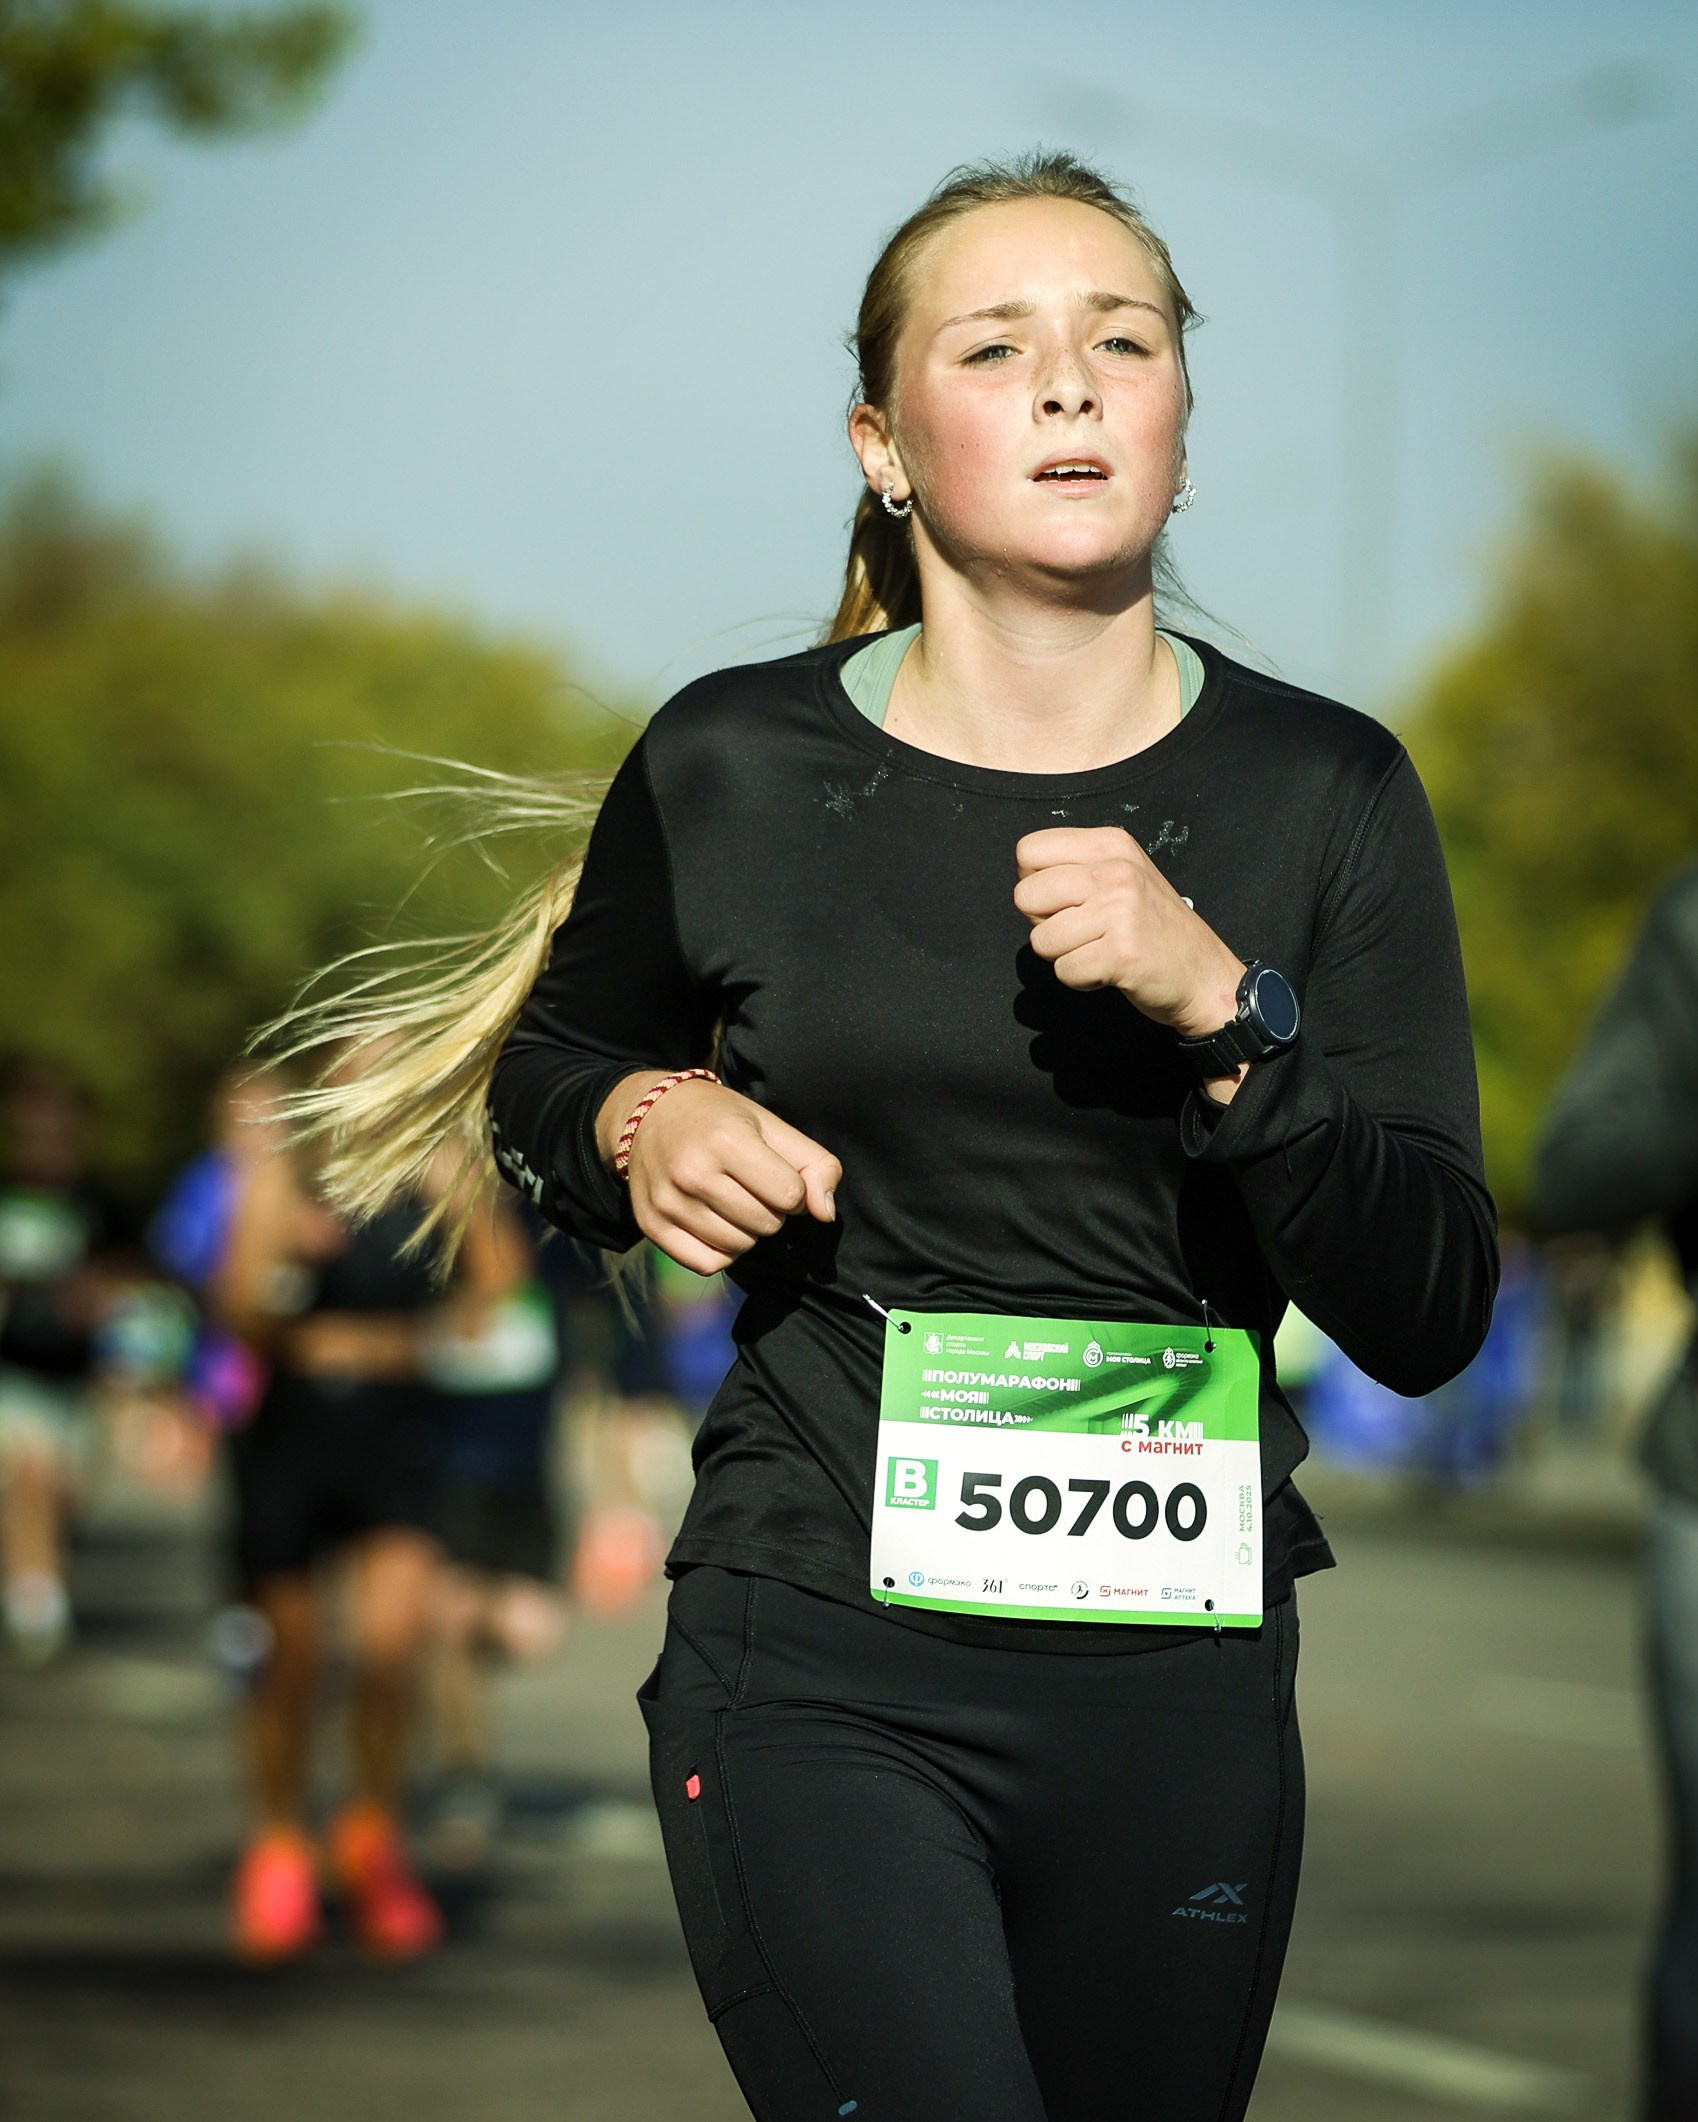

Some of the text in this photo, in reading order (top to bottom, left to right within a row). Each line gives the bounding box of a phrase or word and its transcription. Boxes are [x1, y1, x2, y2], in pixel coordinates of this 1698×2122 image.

[1121, 1357, 1151, 1365] СТОЛИЦА
[931, 1370, 1072, 1392] ПОЛУМАРАФОН
[1133, 1413, 1151, 1438] 5
[890, 1497, 930, 1507] КЛАСТЕР
[954, 1471, 1208, 1542] 50700
[1113, 1588, 1149, 1597] МАГНИТ
[1171, 1907, 1248, 1923] ATHLEX
